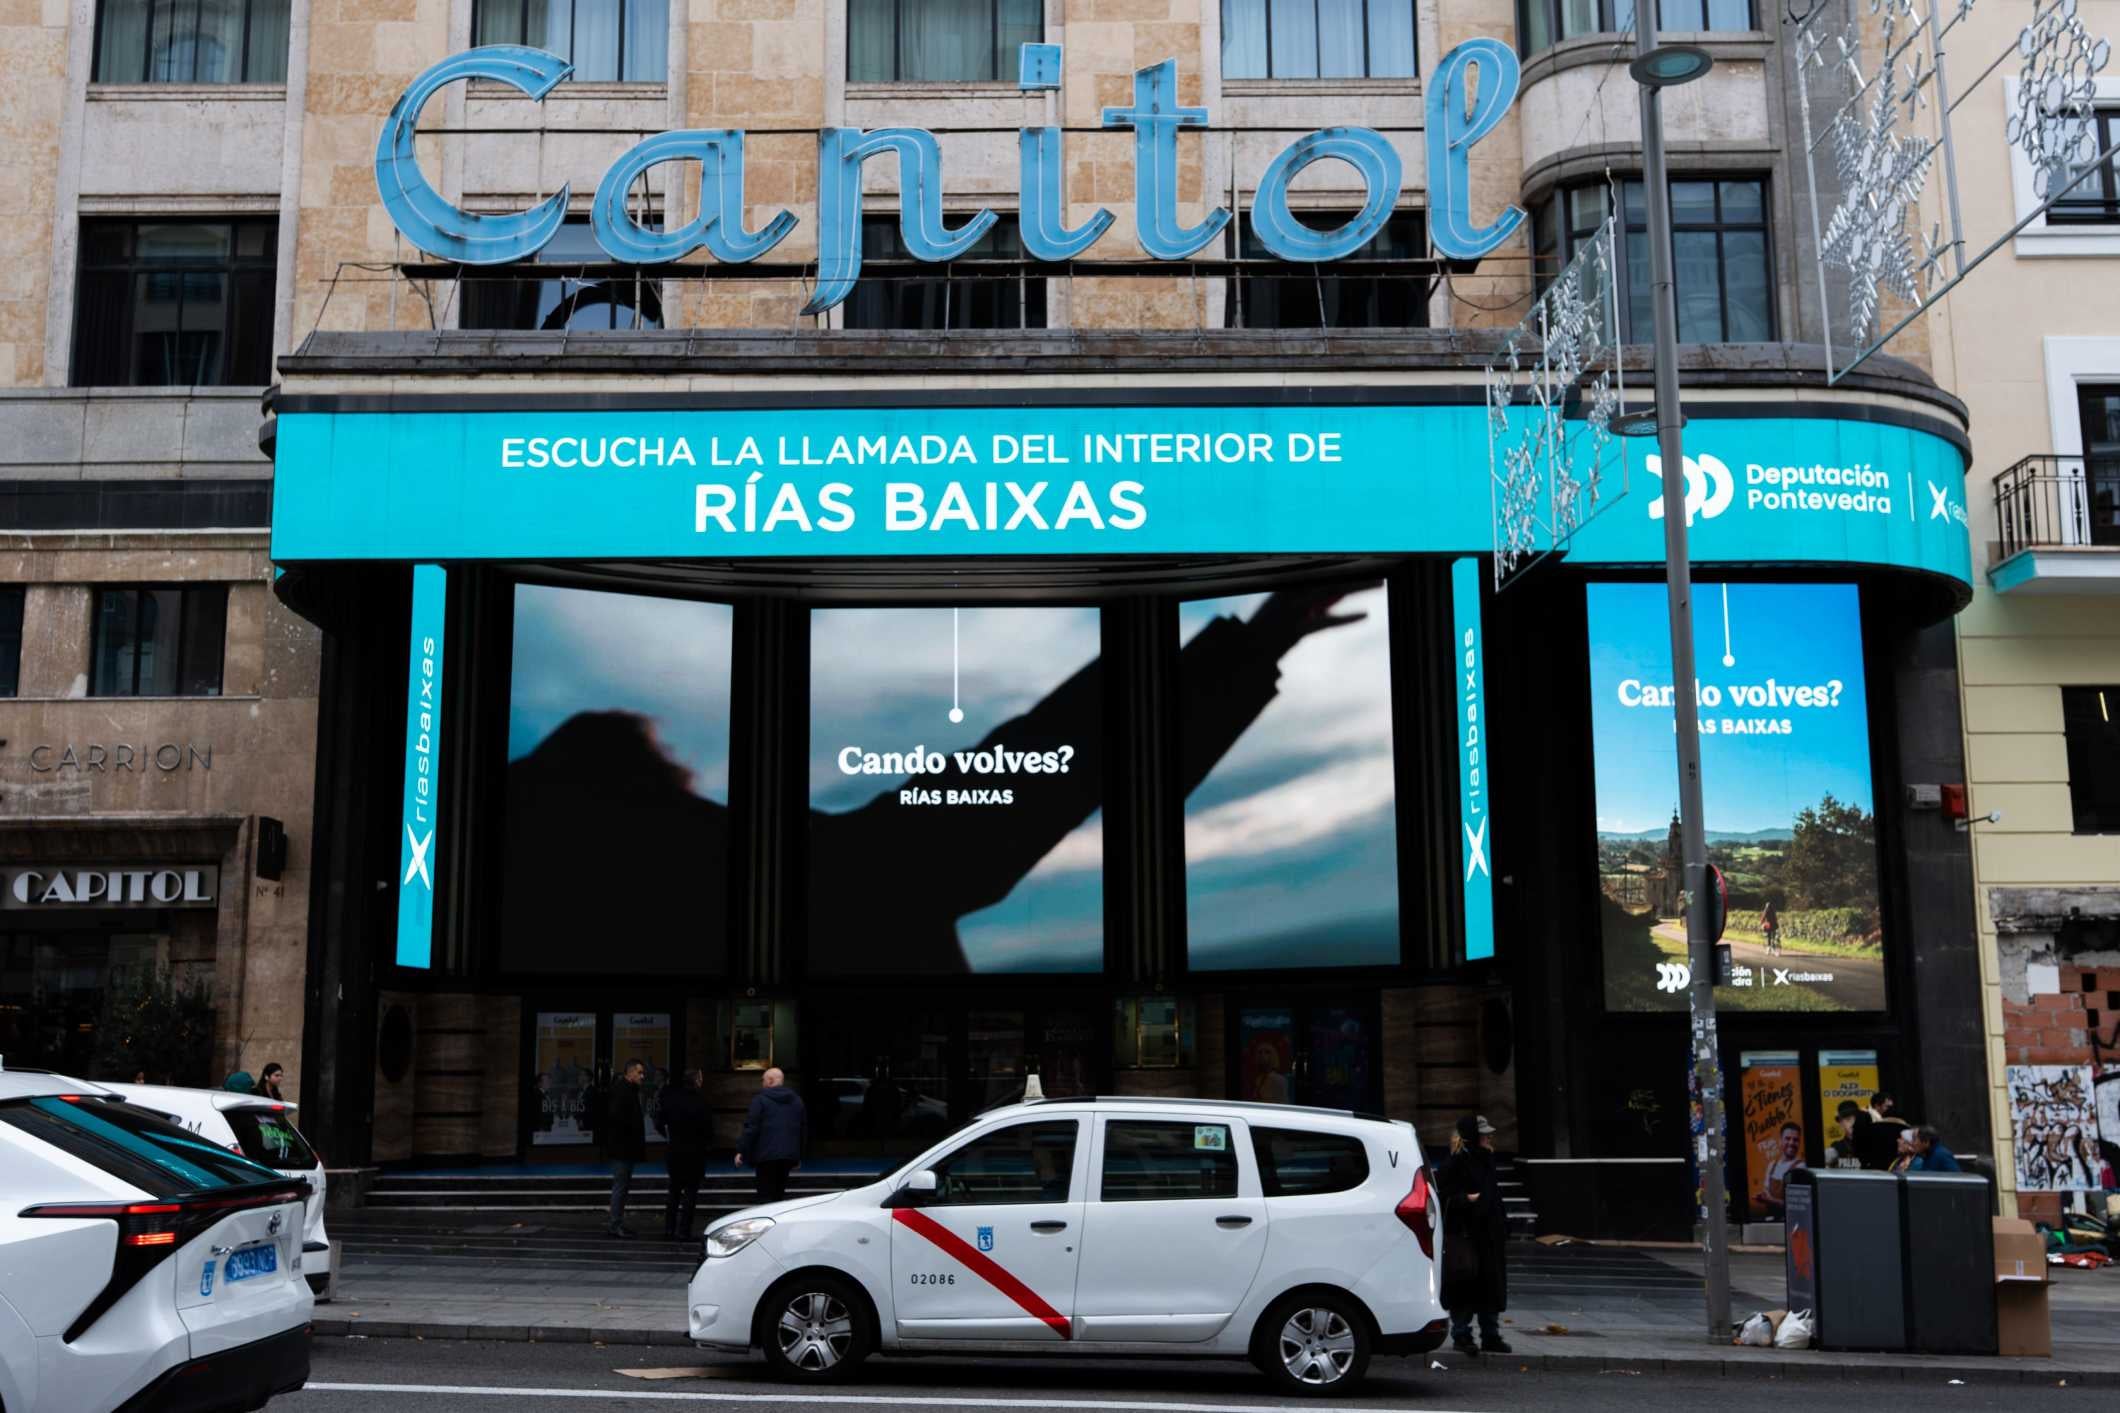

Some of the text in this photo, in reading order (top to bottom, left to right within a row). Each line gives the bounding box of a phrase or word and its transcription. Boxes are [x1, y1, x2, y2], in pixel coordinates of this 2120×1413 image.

[376, 37, 1527, 314] Capitol
[501, 432, 1342, 468] ESCUCHA LA LLAMADA DEL INTERIOR DE
[1746, 464, 1889, 491] Deputación
[695, 471, 1147, 533] RÍAS BAIXAS
[1748, 488, 1891, 514] Pontevedra
[1728, 679, 1843, 707] volves?
[1722, 718, 1792, 735] BAIXAS
[31, 743, 213, 772] CARRION
[838, 744, 1075, 775] Cando volves?
[900, 787, 1014, 805] RÍAS BAIXAS
[13, 870, 213, 903] CAPITOL
[273, 886, 285, 897] 41
[1388, 1150, 1399, 1169] V
[910, 1273, 956, 1286] 02086
